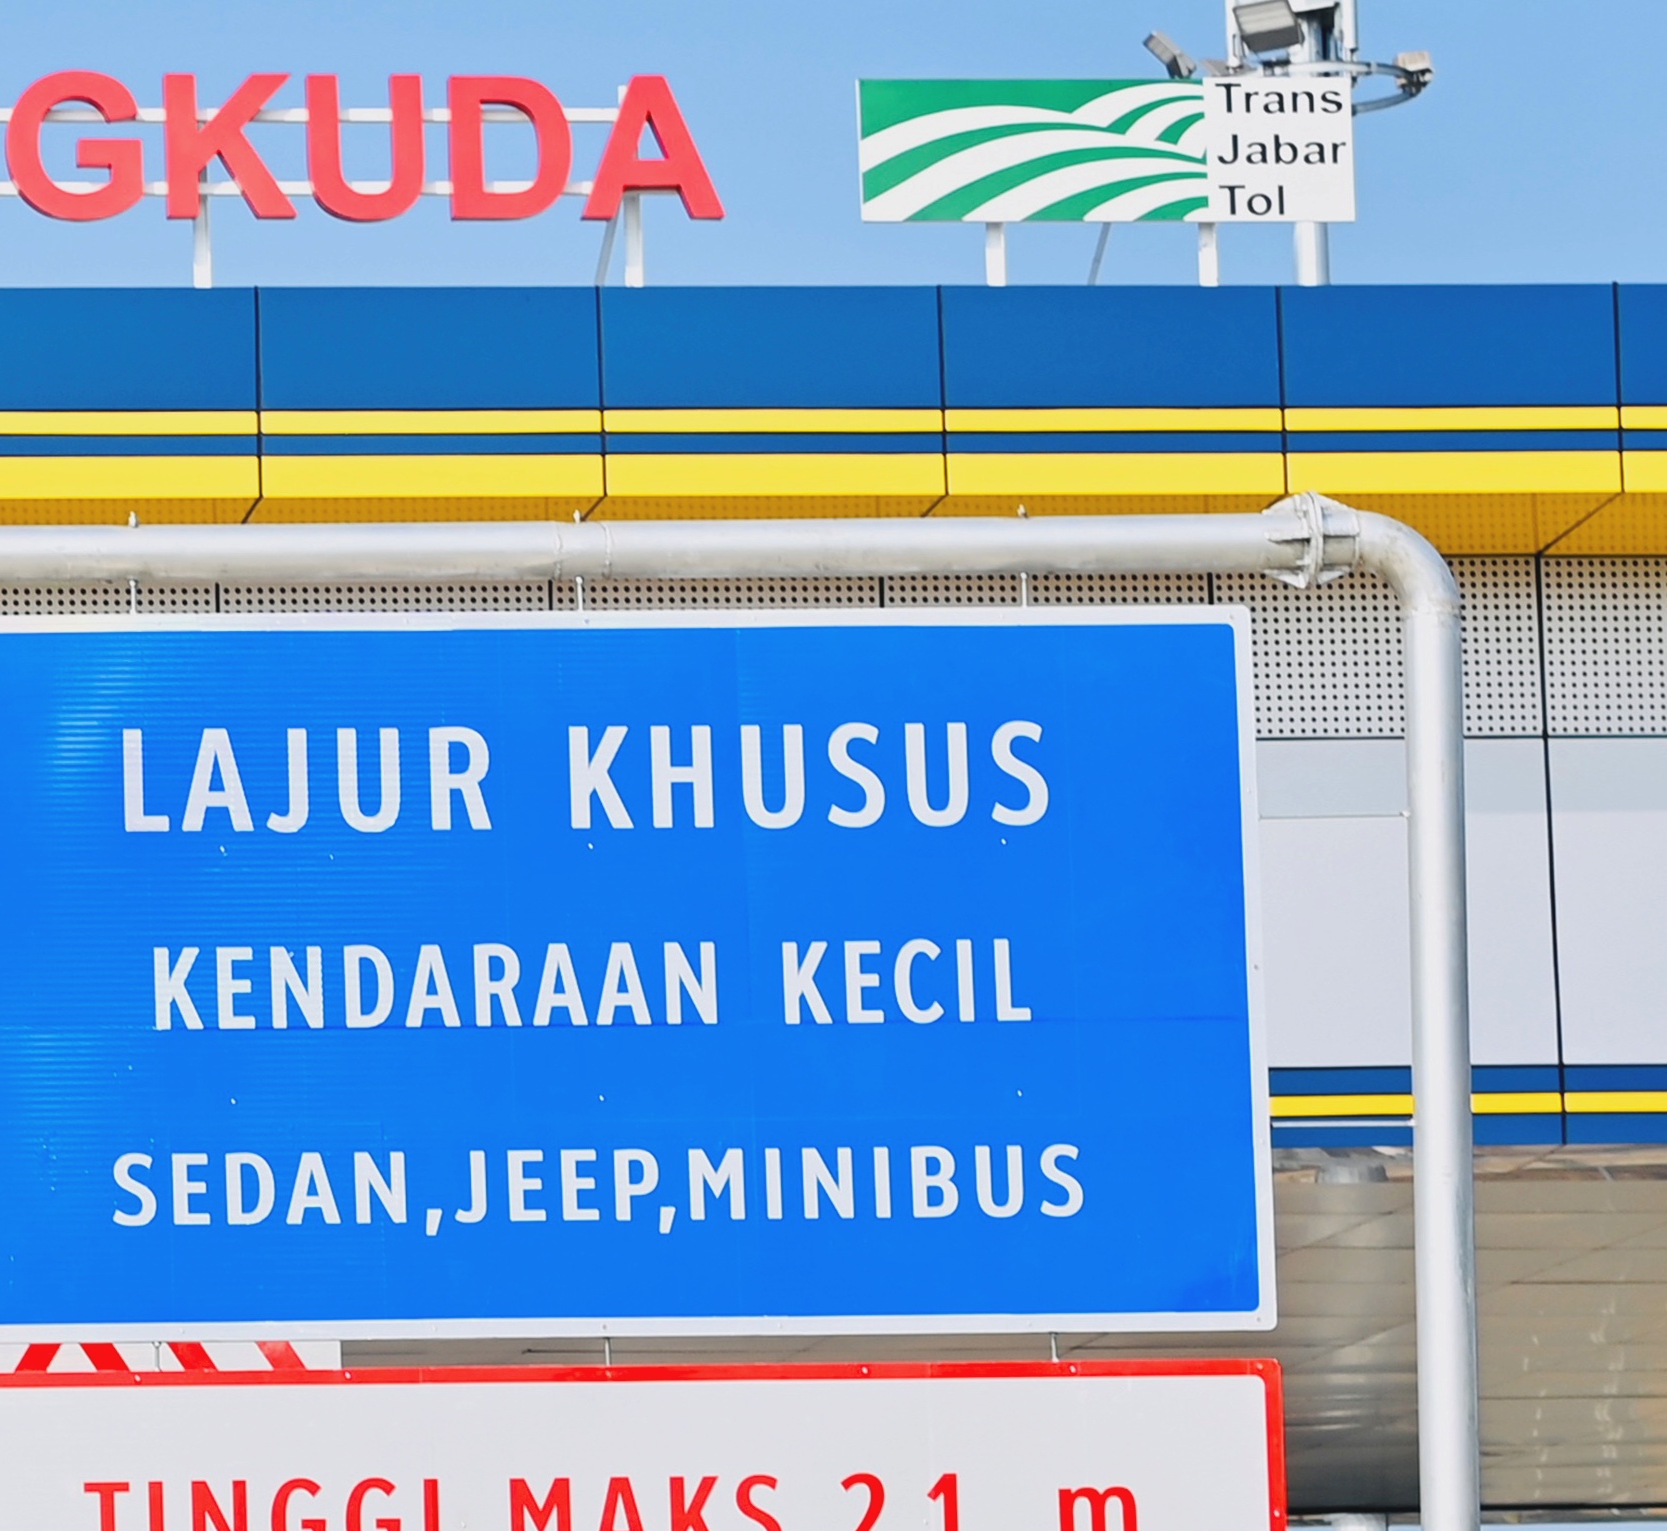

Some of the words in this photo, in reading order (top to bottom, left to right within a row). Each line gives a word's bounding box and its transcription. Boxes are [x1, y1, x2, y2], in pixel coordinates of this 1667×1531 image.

[1215, 82, 1343, 114] Trans
[1217, 134, 1346, 165] Jabar
[1219, 185, 1285, 216] Tol
[122, 726, 492, 833] LAJUR
[568, 720, 1049, 829] KHUSUS
[153, 941, 718, 1031] KENDARAAN
[782, 938, 1032, 1025] KECIL
[113, 1144, 1084, 1236] SEDAN,JEEP,MINIBUS
